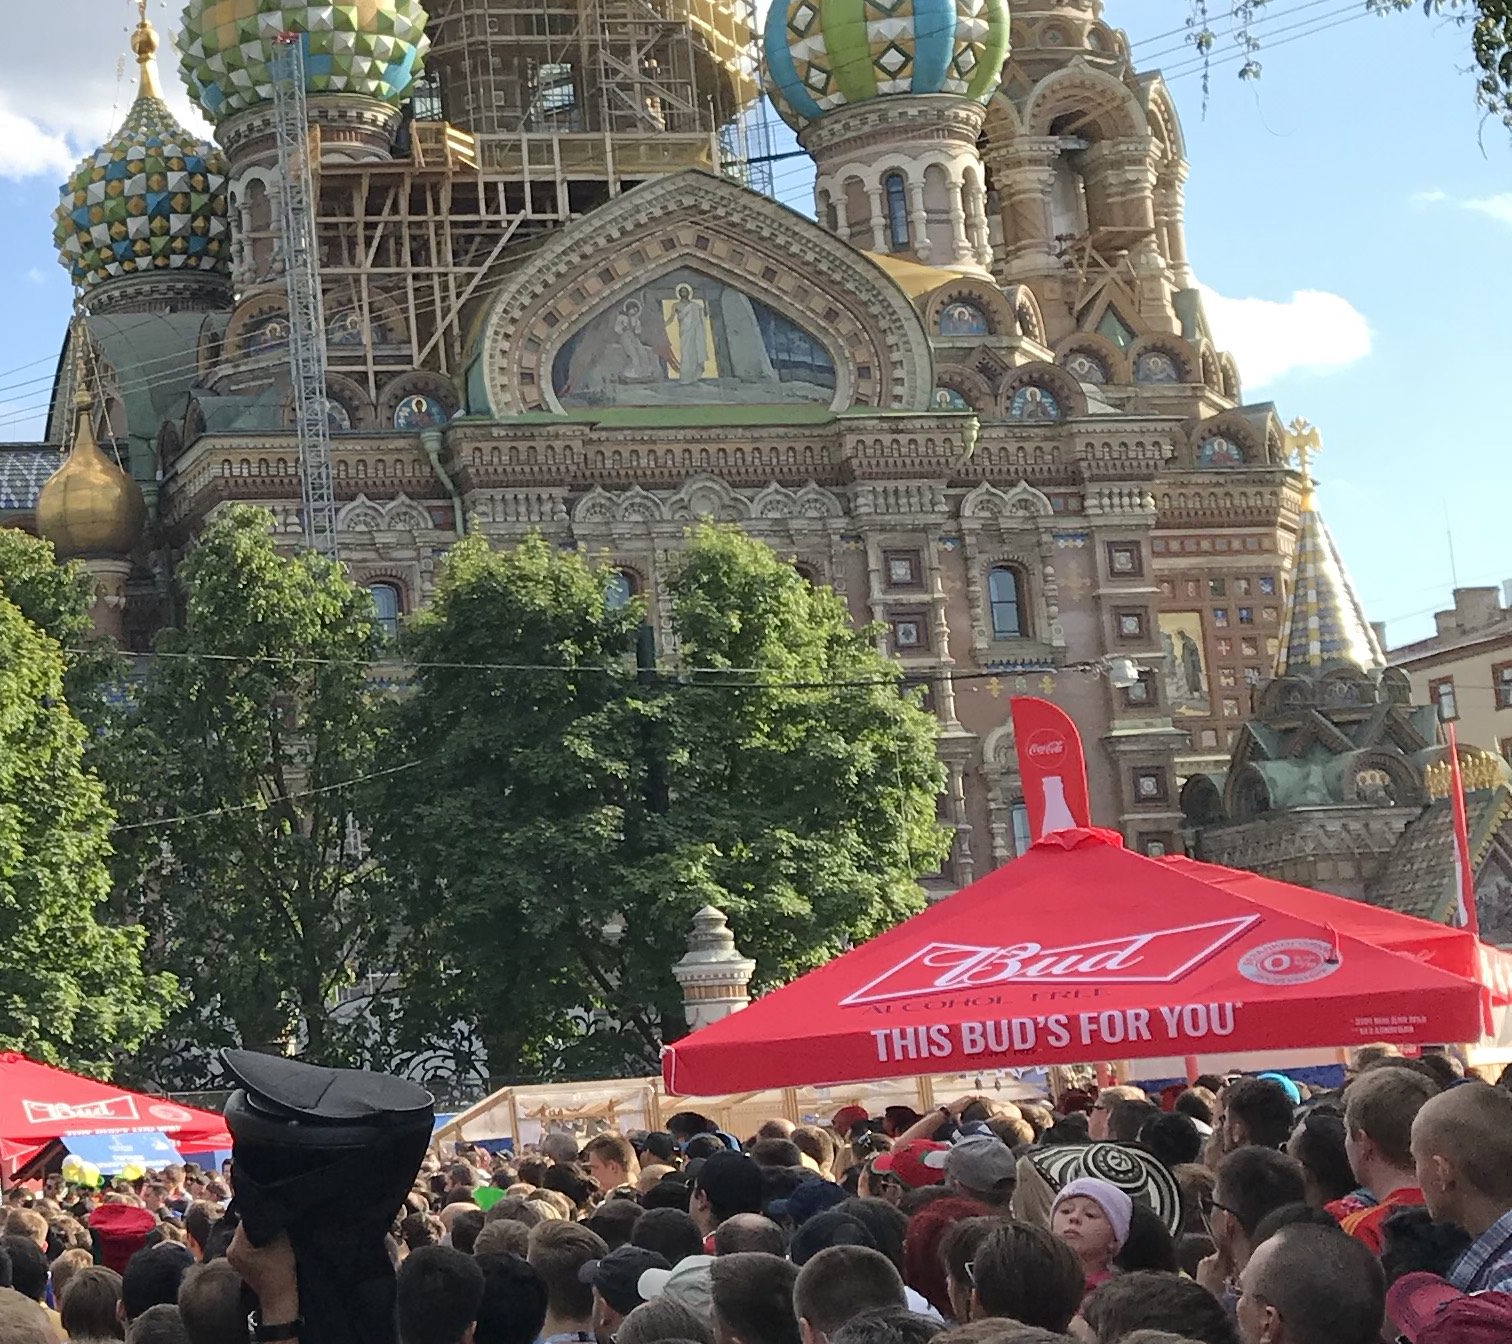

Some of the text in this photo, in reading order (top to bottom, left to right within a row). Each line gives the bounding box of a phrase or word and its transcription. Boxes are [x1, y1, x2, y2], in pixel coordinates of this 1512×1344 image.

[922, 941, 1145, 987] Bud
[870, 1025, 954, 1062] THIS
[1080, 1006, 1153, 1046] FOR
[31, 1102, 115, 1119] Bud
